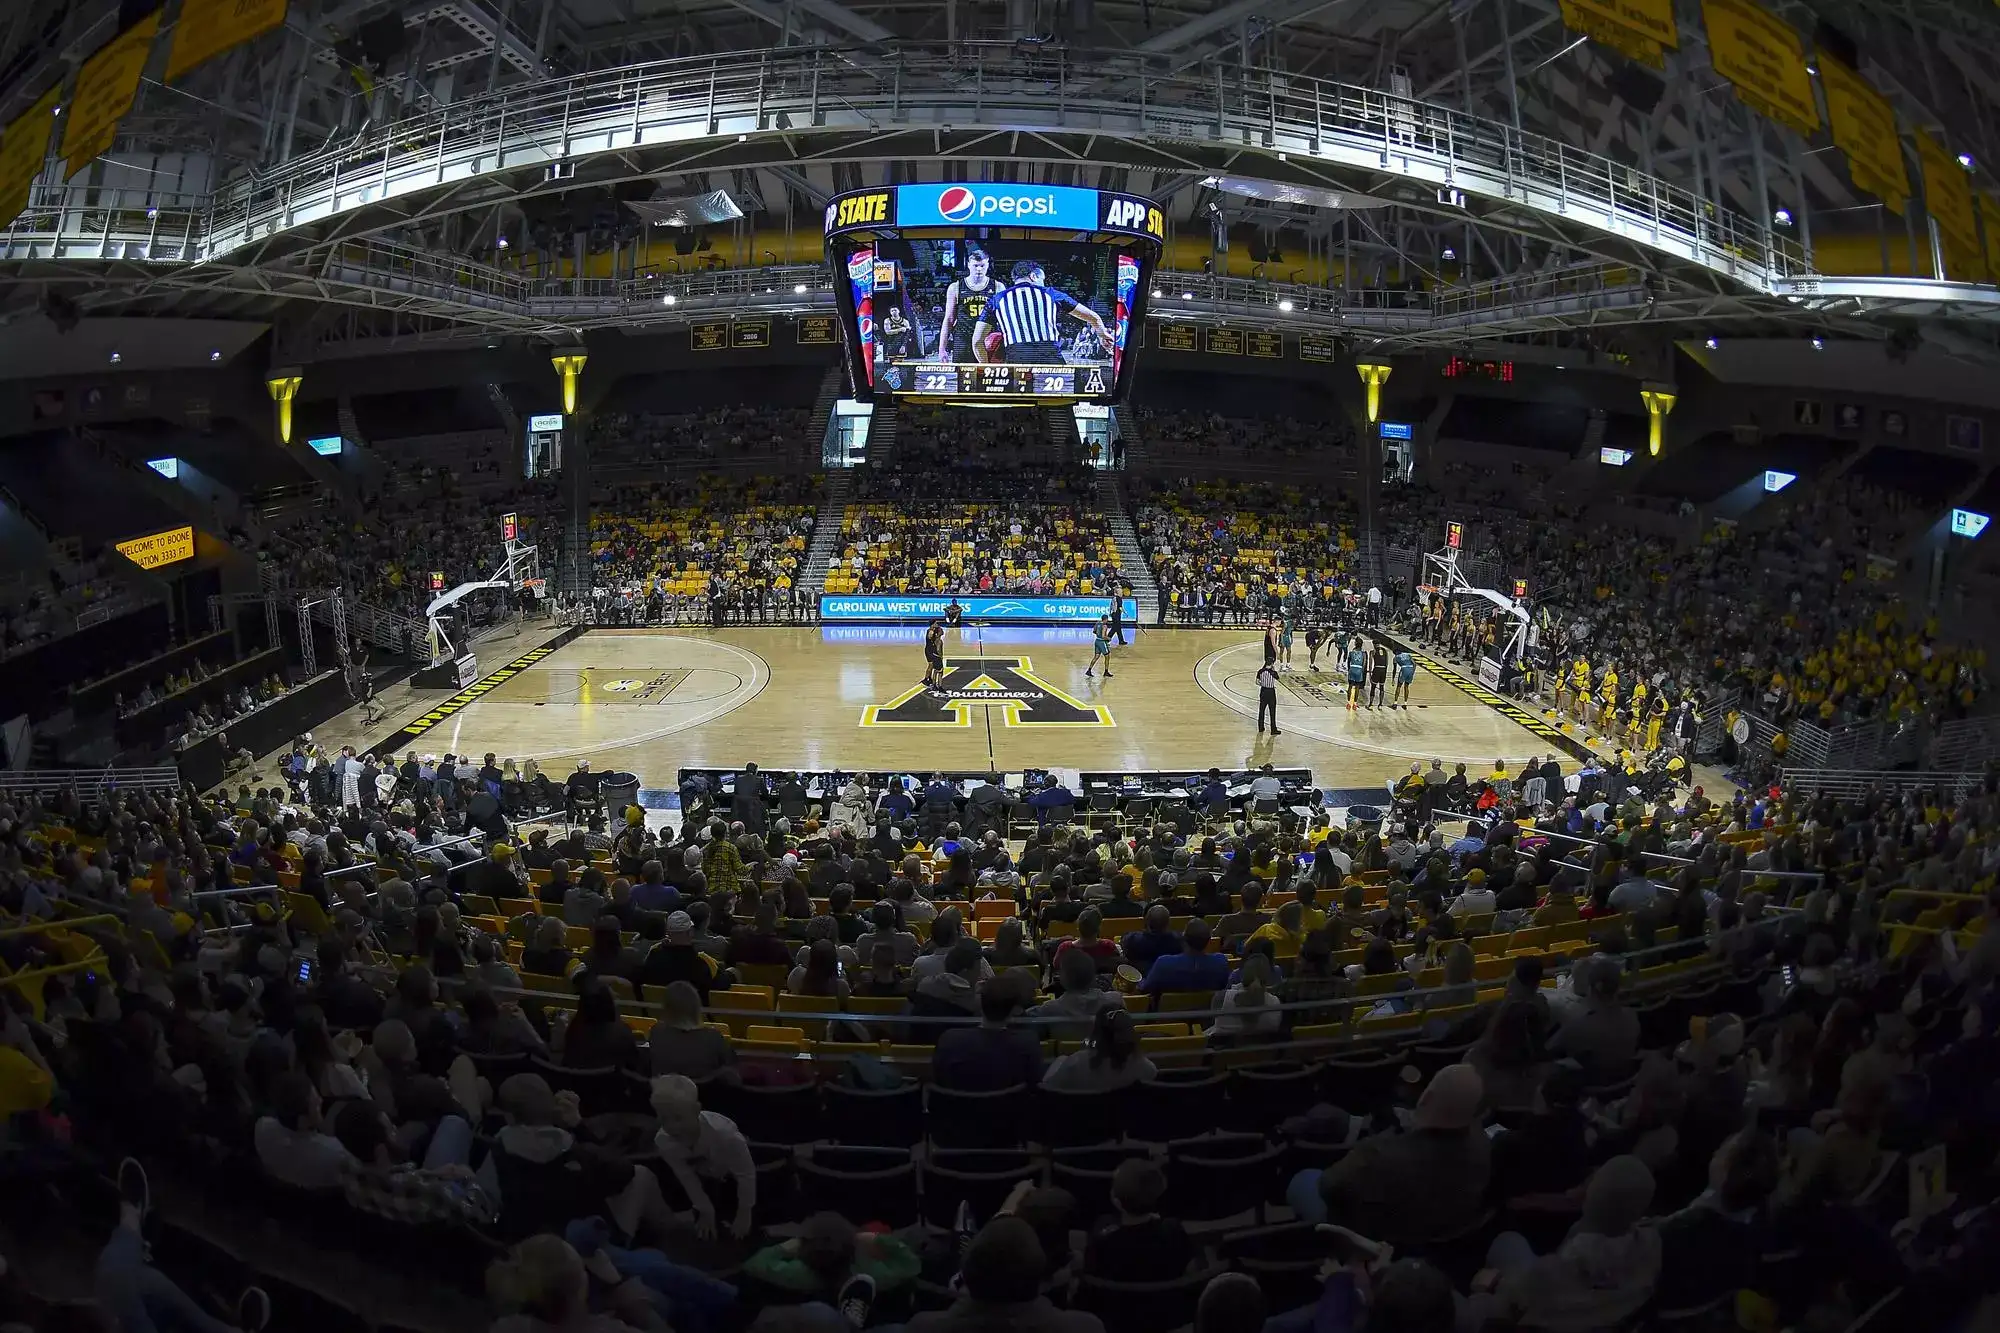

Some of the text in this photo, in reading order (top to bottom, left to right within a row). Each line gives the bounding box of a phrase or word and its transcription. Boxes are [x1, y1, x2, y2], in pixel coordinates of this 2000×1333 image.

[838, 194, 888, 227] STATE
[980, 194, 1055, 218] pepsi
[1106, 199, 1146, 229] APP
[806, 319, 829, 327] NCAA
[984, 366, 1009, 378] 9:10
[924, 375, 947, 390] 22
[1042, 376, 1064, 391] 20
[121, 531, 190, 556] WELCOME TO BOONE
[161, 549, 177, 561] 3333
[829, 602, 1111, 616] CAROLINA WEST WIRESS Go stay connec
[403, 647, 555, 735] APPALACHIAN STATE
[1497, 706, 1562, 737] STATE
